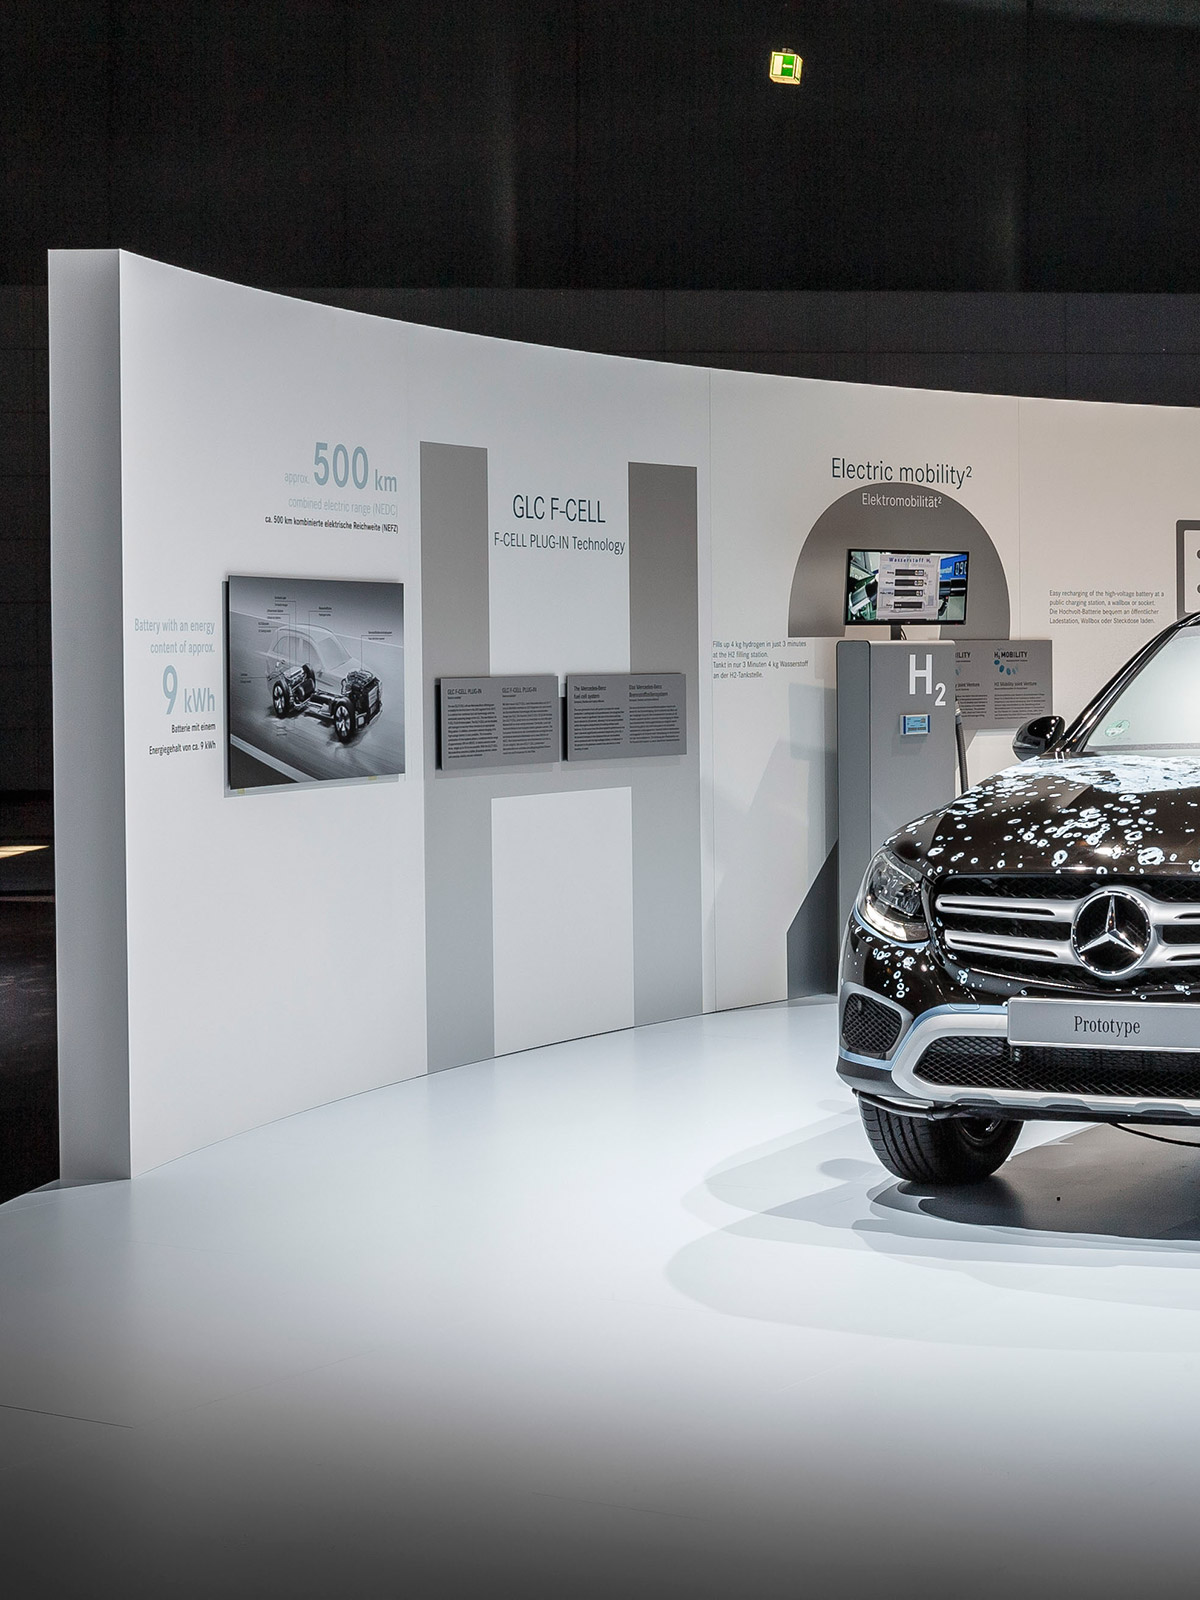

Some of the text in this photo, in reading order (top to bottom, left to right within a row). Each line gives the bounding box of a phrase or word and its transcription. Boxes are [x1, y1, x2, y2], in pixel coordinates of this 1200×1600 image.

[313, 441, 369, 490] 500
[374, 469, 398, 493] km
[831, 457, 893, 482] Electric
[288, 497, 322, 511] combined
[351, 503, 371, 517] range
[512, 494, 606, 523] GLC F-CELL
[273, 515, 284, 525] 500
[284, 516, 293, 525] km
[293, 516, 324, 527] kombinierte
[324, 519, 353, 530] elektrische
[353, 521, 381, 532] Reichweite
[381, 523, 399, 534] (NEFZ)
[494, 531, 626, 556] F-CELL PLUG-IN Technology
[1049, 589, 1061, 598] Easy
[1062, 589, 1088, 598] recharging
[1105, 590, 1135, 598] high-voltage
[1136, 590, 1154, 598] battery
[1049, 599, 1064, 607] public
[1065, 599, 1087, 607] charging
[134, 618, 216, 635] Battery with an energy
[150, 640, 216, 657] content of approx.
[742, 640, 765, 649] hydrogen
[162, 664, 216, 715] 9 kWh
[171, 722, 216, 733] Batterie mit einem
[149, 744, 181, 756] Energiegehalt
[182, 744, 192, 752] von
[204, 740, 216, 750] kWh
[1073, 1015, 1141, 1038] Prototype
